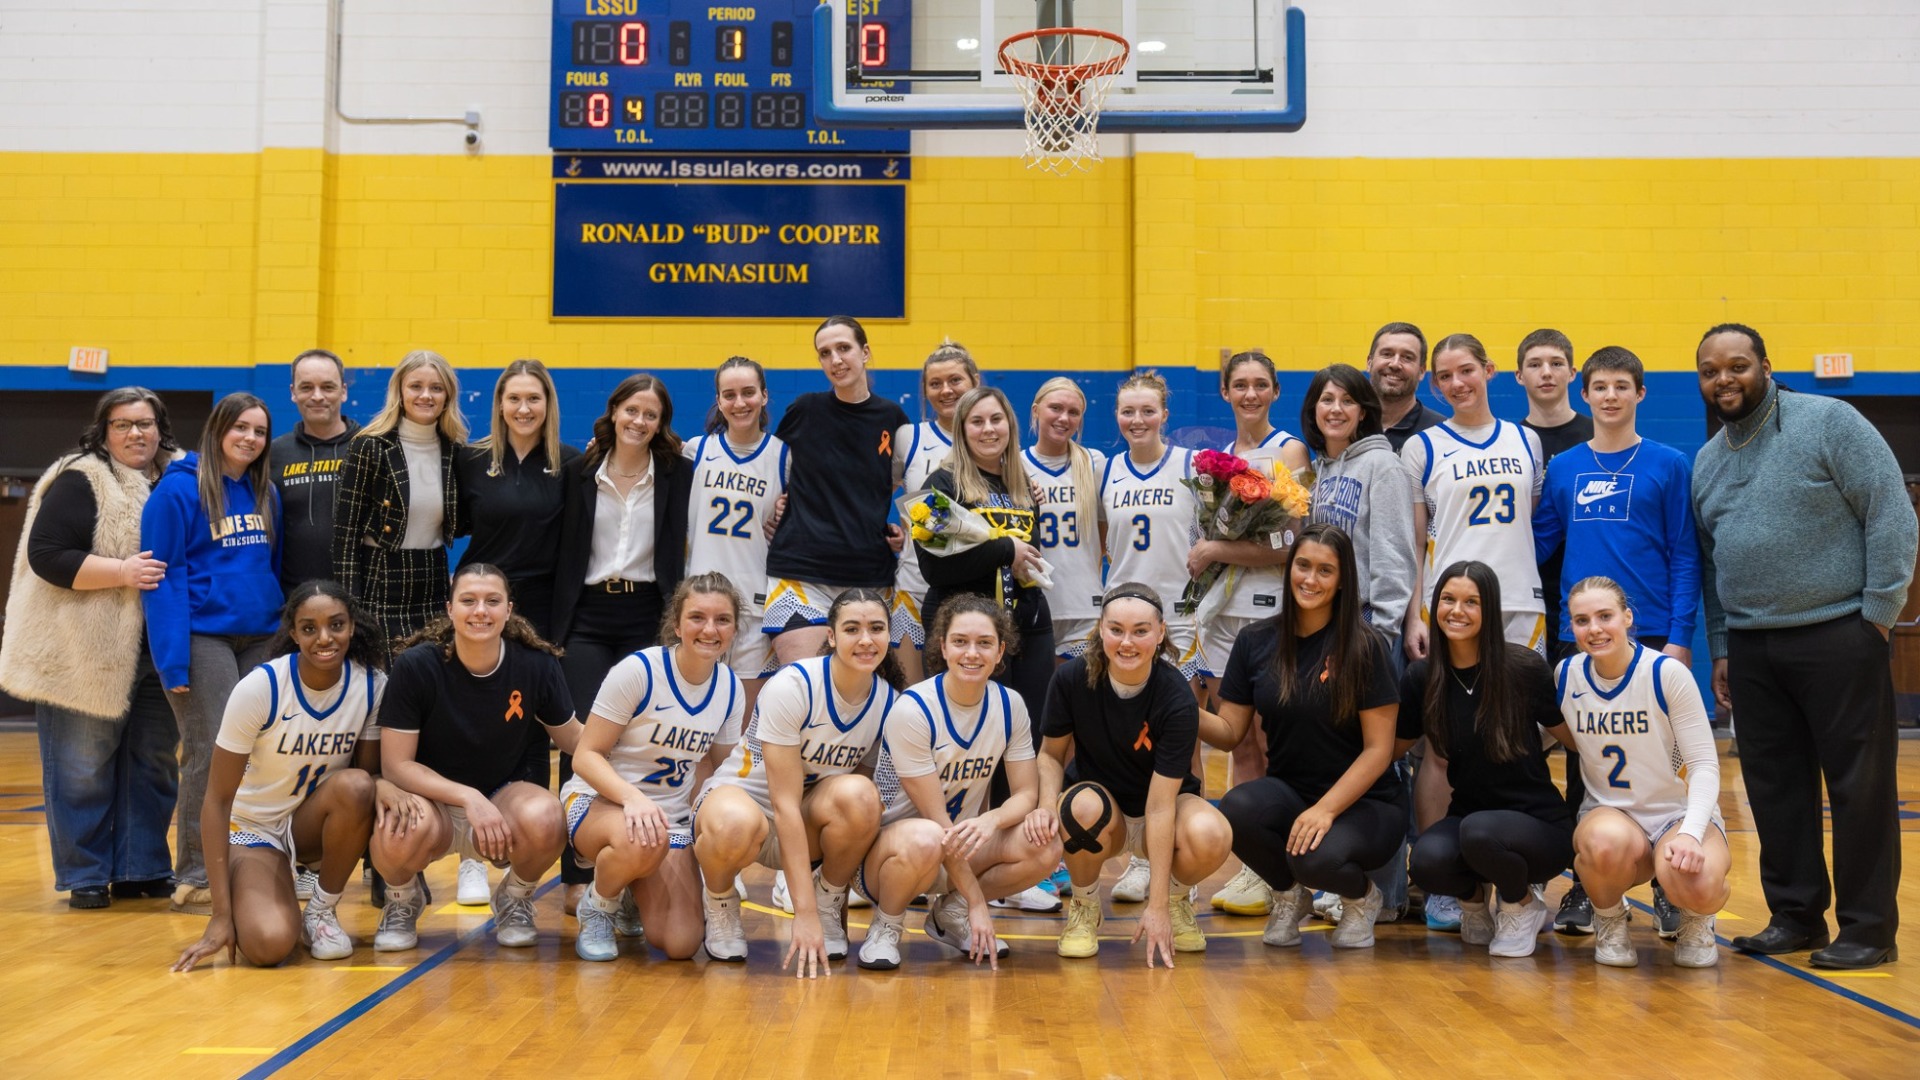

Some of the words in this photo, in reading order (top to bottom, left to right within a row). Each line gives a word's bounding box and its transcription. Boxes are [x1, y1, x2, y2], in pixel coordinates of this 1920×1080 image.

[586, 0, 638, 15] LSSU
[708, 7, 756, 20] PERIOD
[620, 23, 646, 65] 0
[733, 30, 742, 59] 1
[861, 24, 885, 66] 0
[566, 72, 609, 86] FOULS
[674, 73, 702, 87] PLYR
[714, 73, 748, 87] FOUL
[771, 73, 792, 87] PTS
[588, 93, 609, 127] 0
[626, 100, 642, 121] 4
[614, 129, 654, 143] T.O.L.
[806, 130, 845, 144] T.O.L.
[602, 160, 862, 178] www.lssulakers.com
[581, 223, 685, 243] RONALD
[778, 224, 880, 244] COOPER
[649, 262, 809, 283] GYMNASIUM
[75, 349, 101, 369] EXIT
[1823, 355, 1847, 375] EXIT
[283, 462, 309, 477] LAKE
[1453, 457, 1523, 481] LAKERS
[704, 469, 767, 498] LAKERS
[1584, 480, 1618, 494] NIKE
[1113, 488, 1174, 510] LAKERS
[1467, 483, 1516, 527] 23
[1584, 505, 1616, 514] AIR
[707, 496, 755, 540] 22
[1039, 511, 1080, 549] 33
[1132, 513, 1151, 552] 3
[1577, 710, 1649, 735] LAKERS
[276, 732, 356, 756] LAKERS
[800, 739, 866, 767] LAKERS
[1601, 744, 1632, 790] 2
